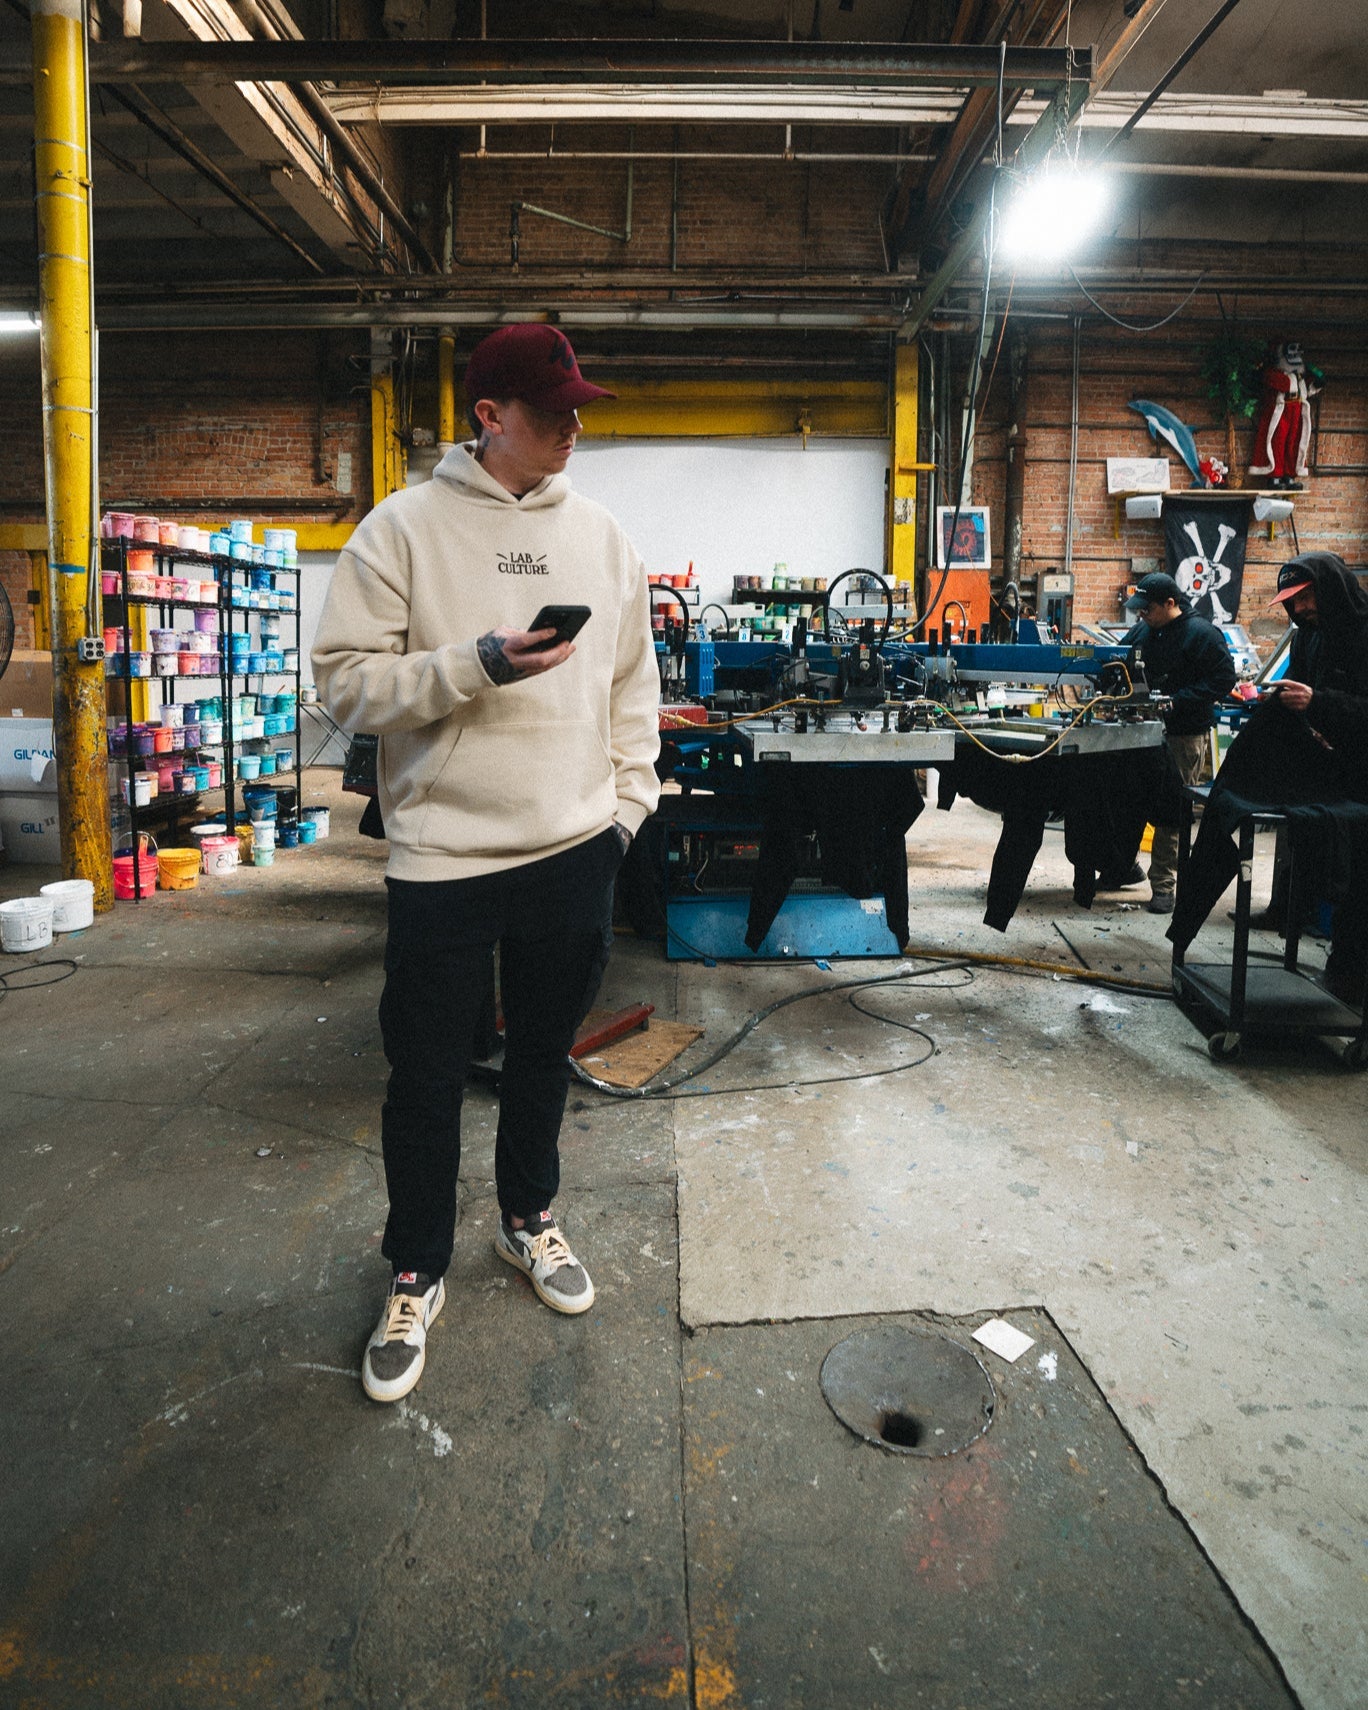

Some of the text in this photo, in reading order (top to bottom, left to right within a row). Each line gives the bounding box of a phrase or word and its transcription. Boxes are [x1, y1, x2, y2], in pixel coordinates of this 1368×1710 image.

[510, 552, 533, 564] LAB
[498, 562, 549, 575] CULTURE
[699, 630, 706, 640] 3
